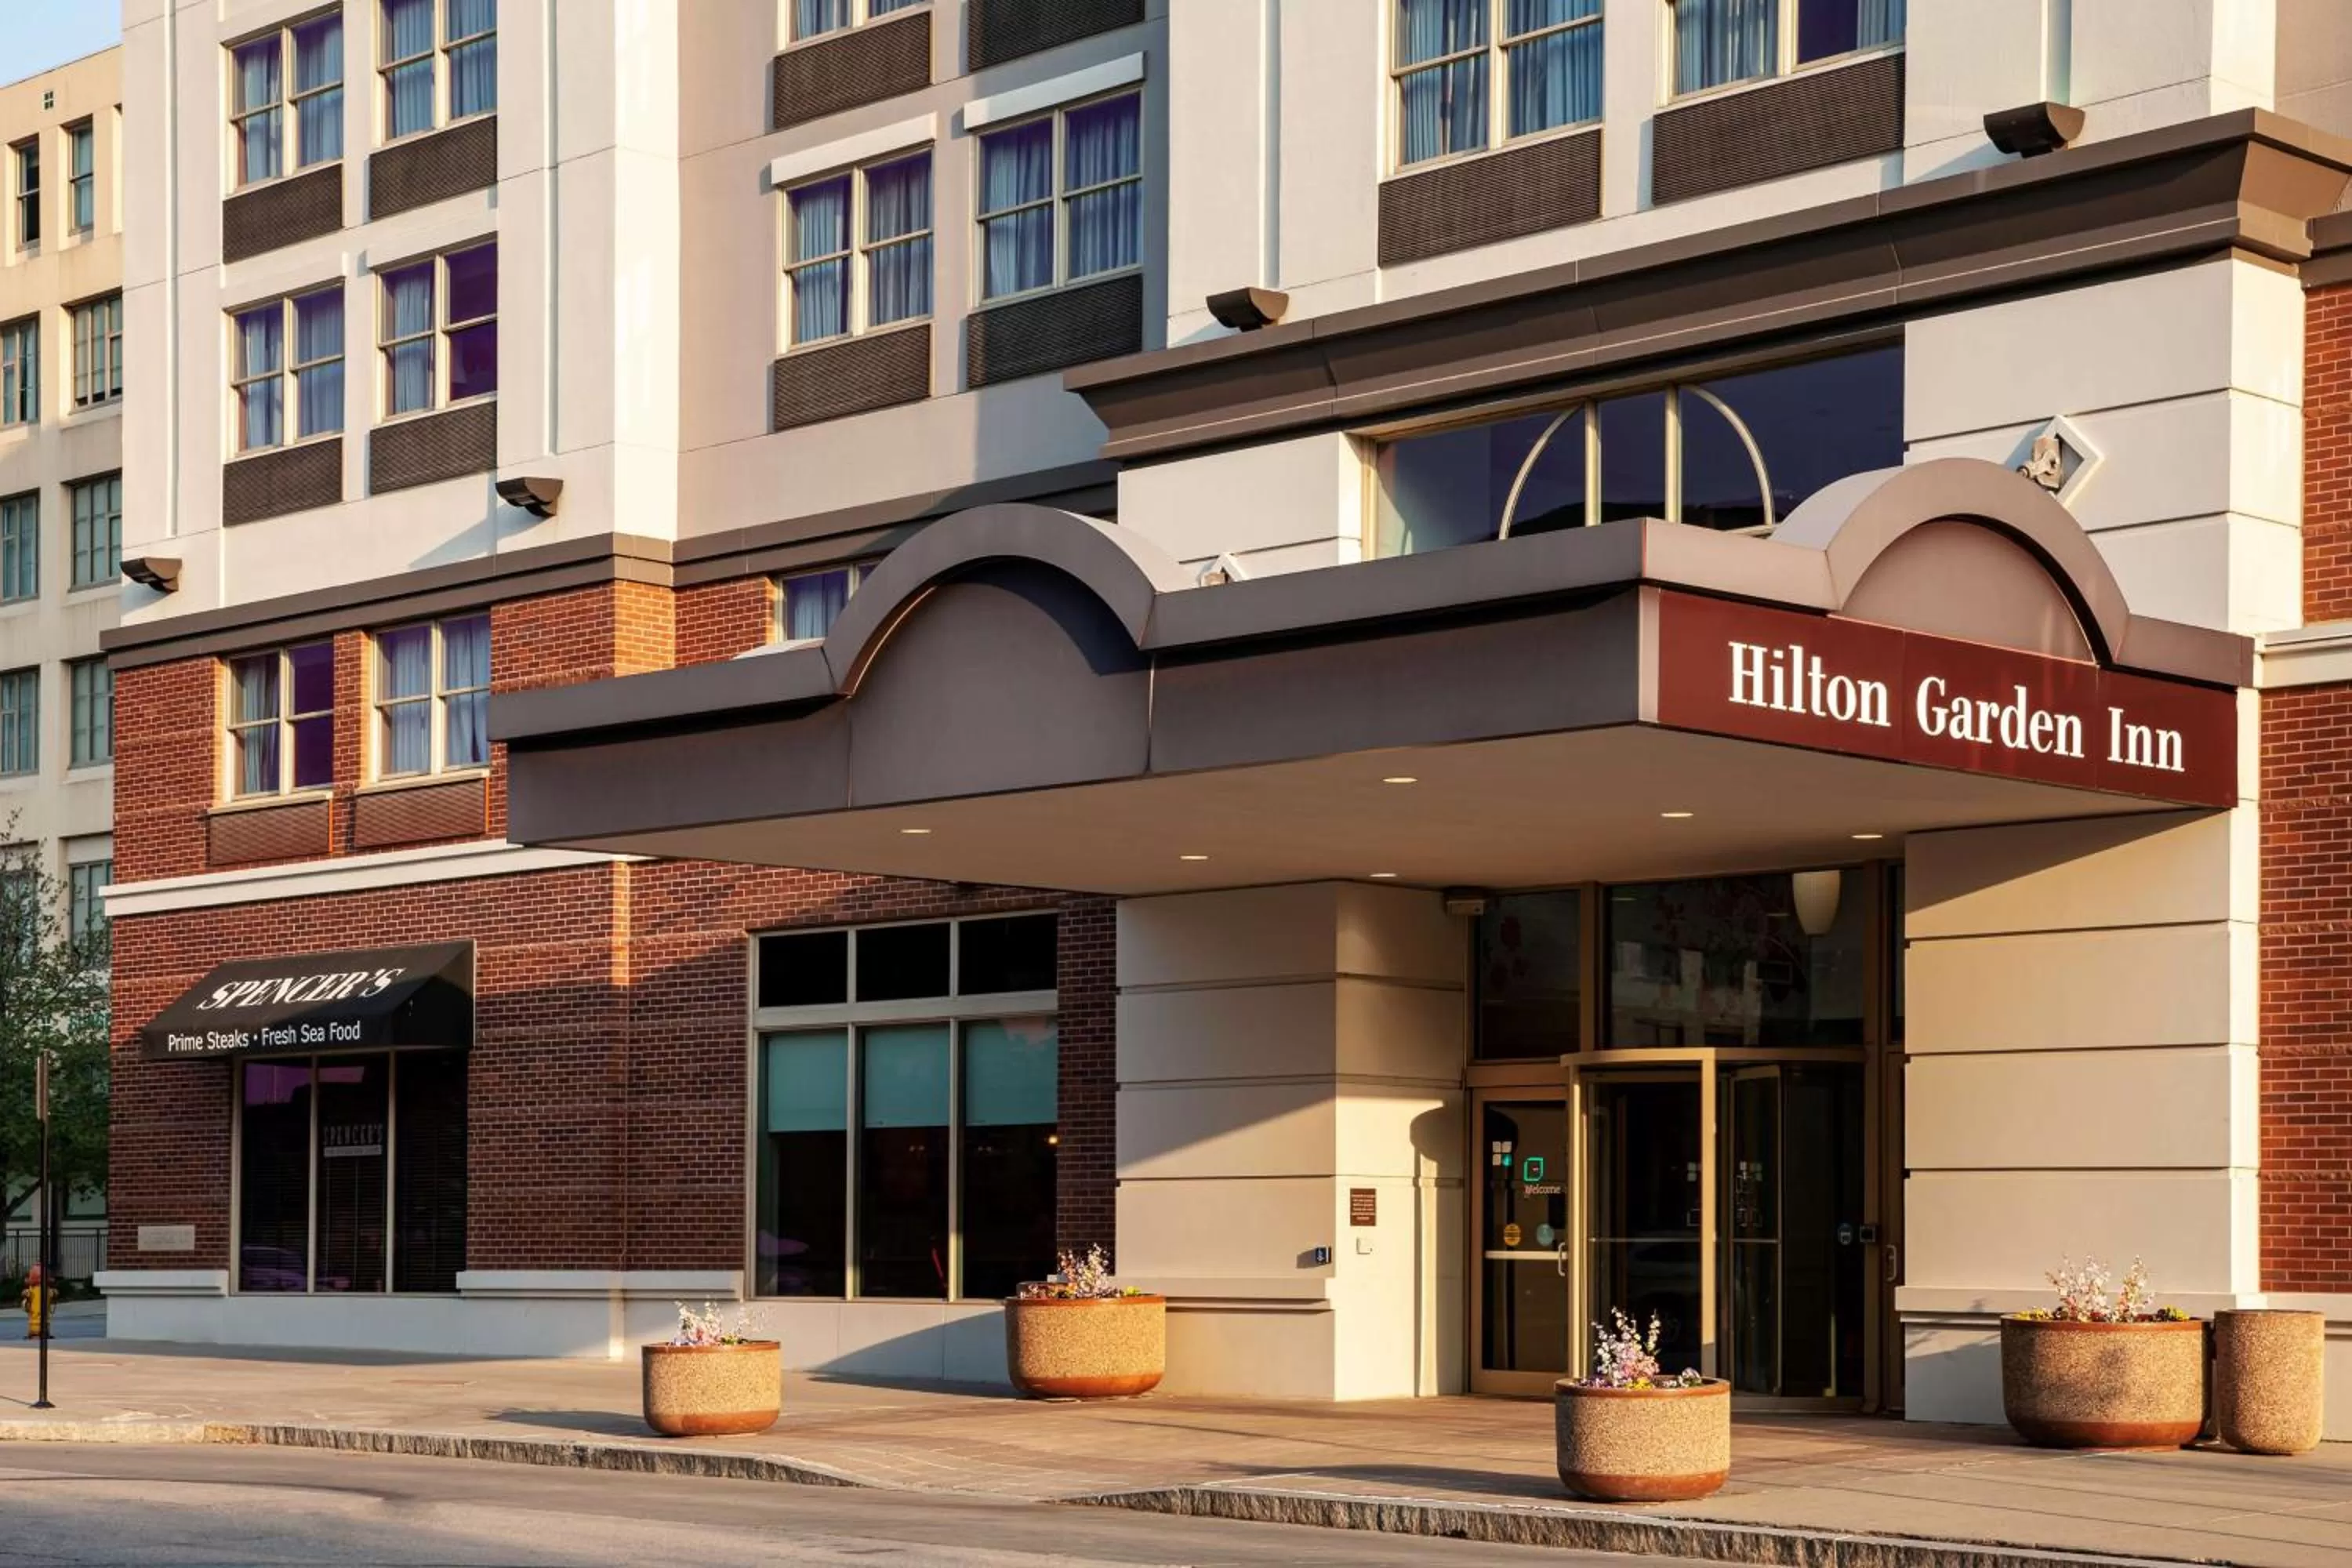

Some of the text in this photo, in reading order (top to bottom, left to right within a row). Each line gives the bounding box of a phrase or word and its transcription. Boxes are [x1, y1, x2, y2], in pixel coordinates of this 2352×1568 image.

[1728, 641, 2186, 773] Hilton Garden Inn
[196, 967, 406, 1010] SPENCER'S
[168, 1020, 361, 1052] Prime Steaks Fresh Sea Food
